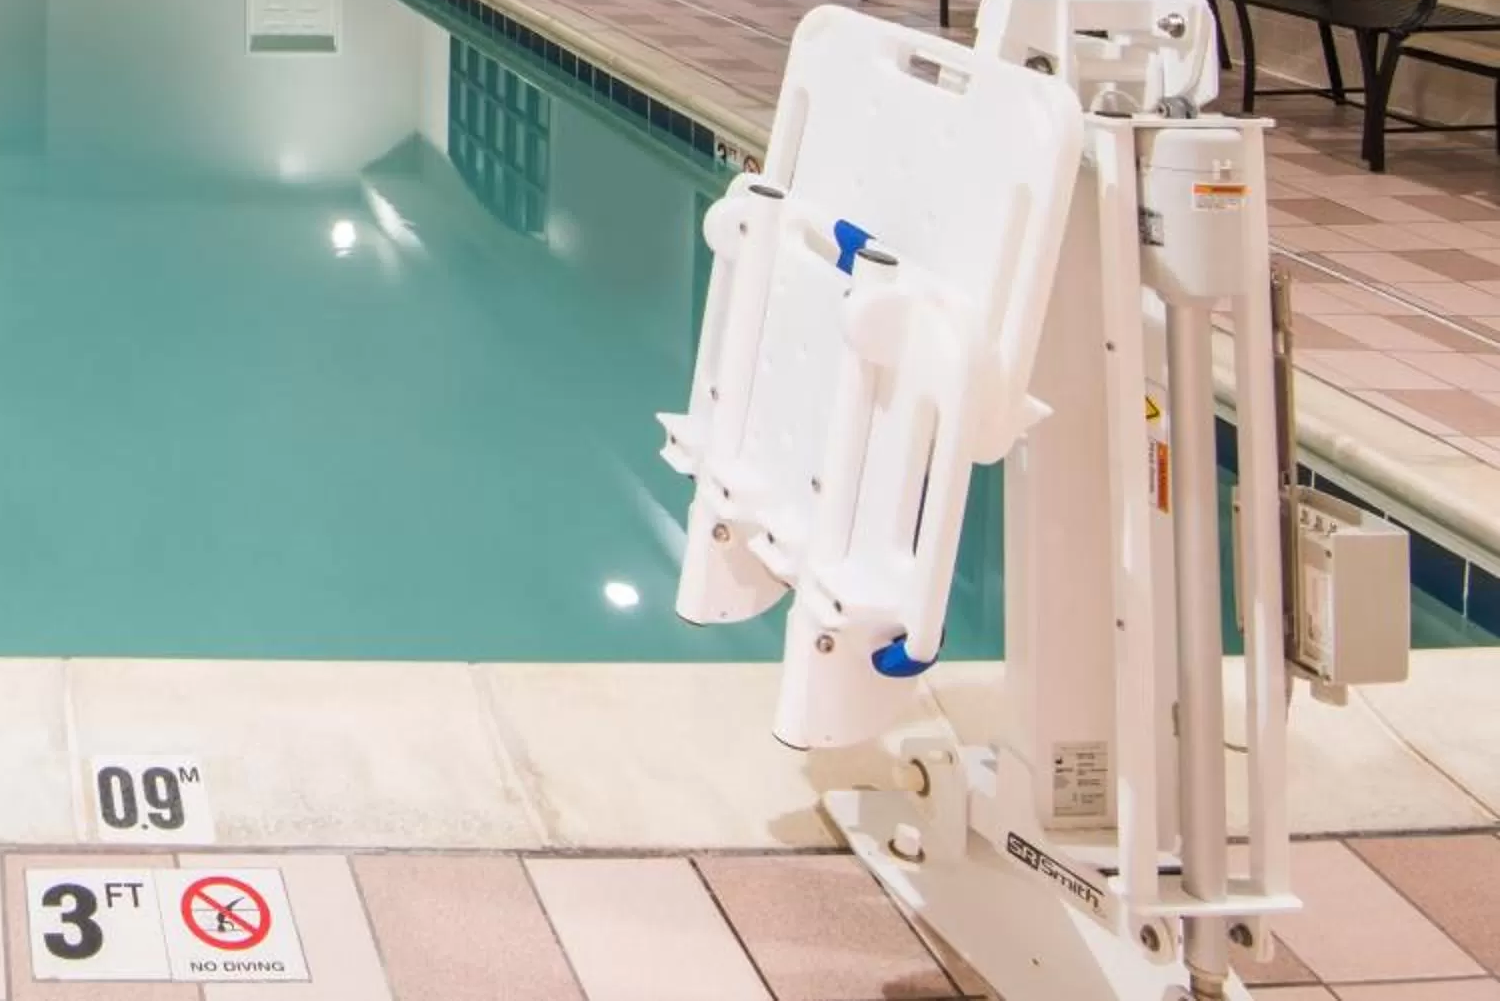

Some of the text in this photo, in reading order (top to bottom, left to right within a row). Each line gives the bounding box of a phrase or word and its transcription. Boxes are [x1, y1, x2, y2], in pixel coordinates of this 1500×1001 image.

[42, 883, 144, 960] 3 FT
[190, 961, 285, 972] NO DIVING
